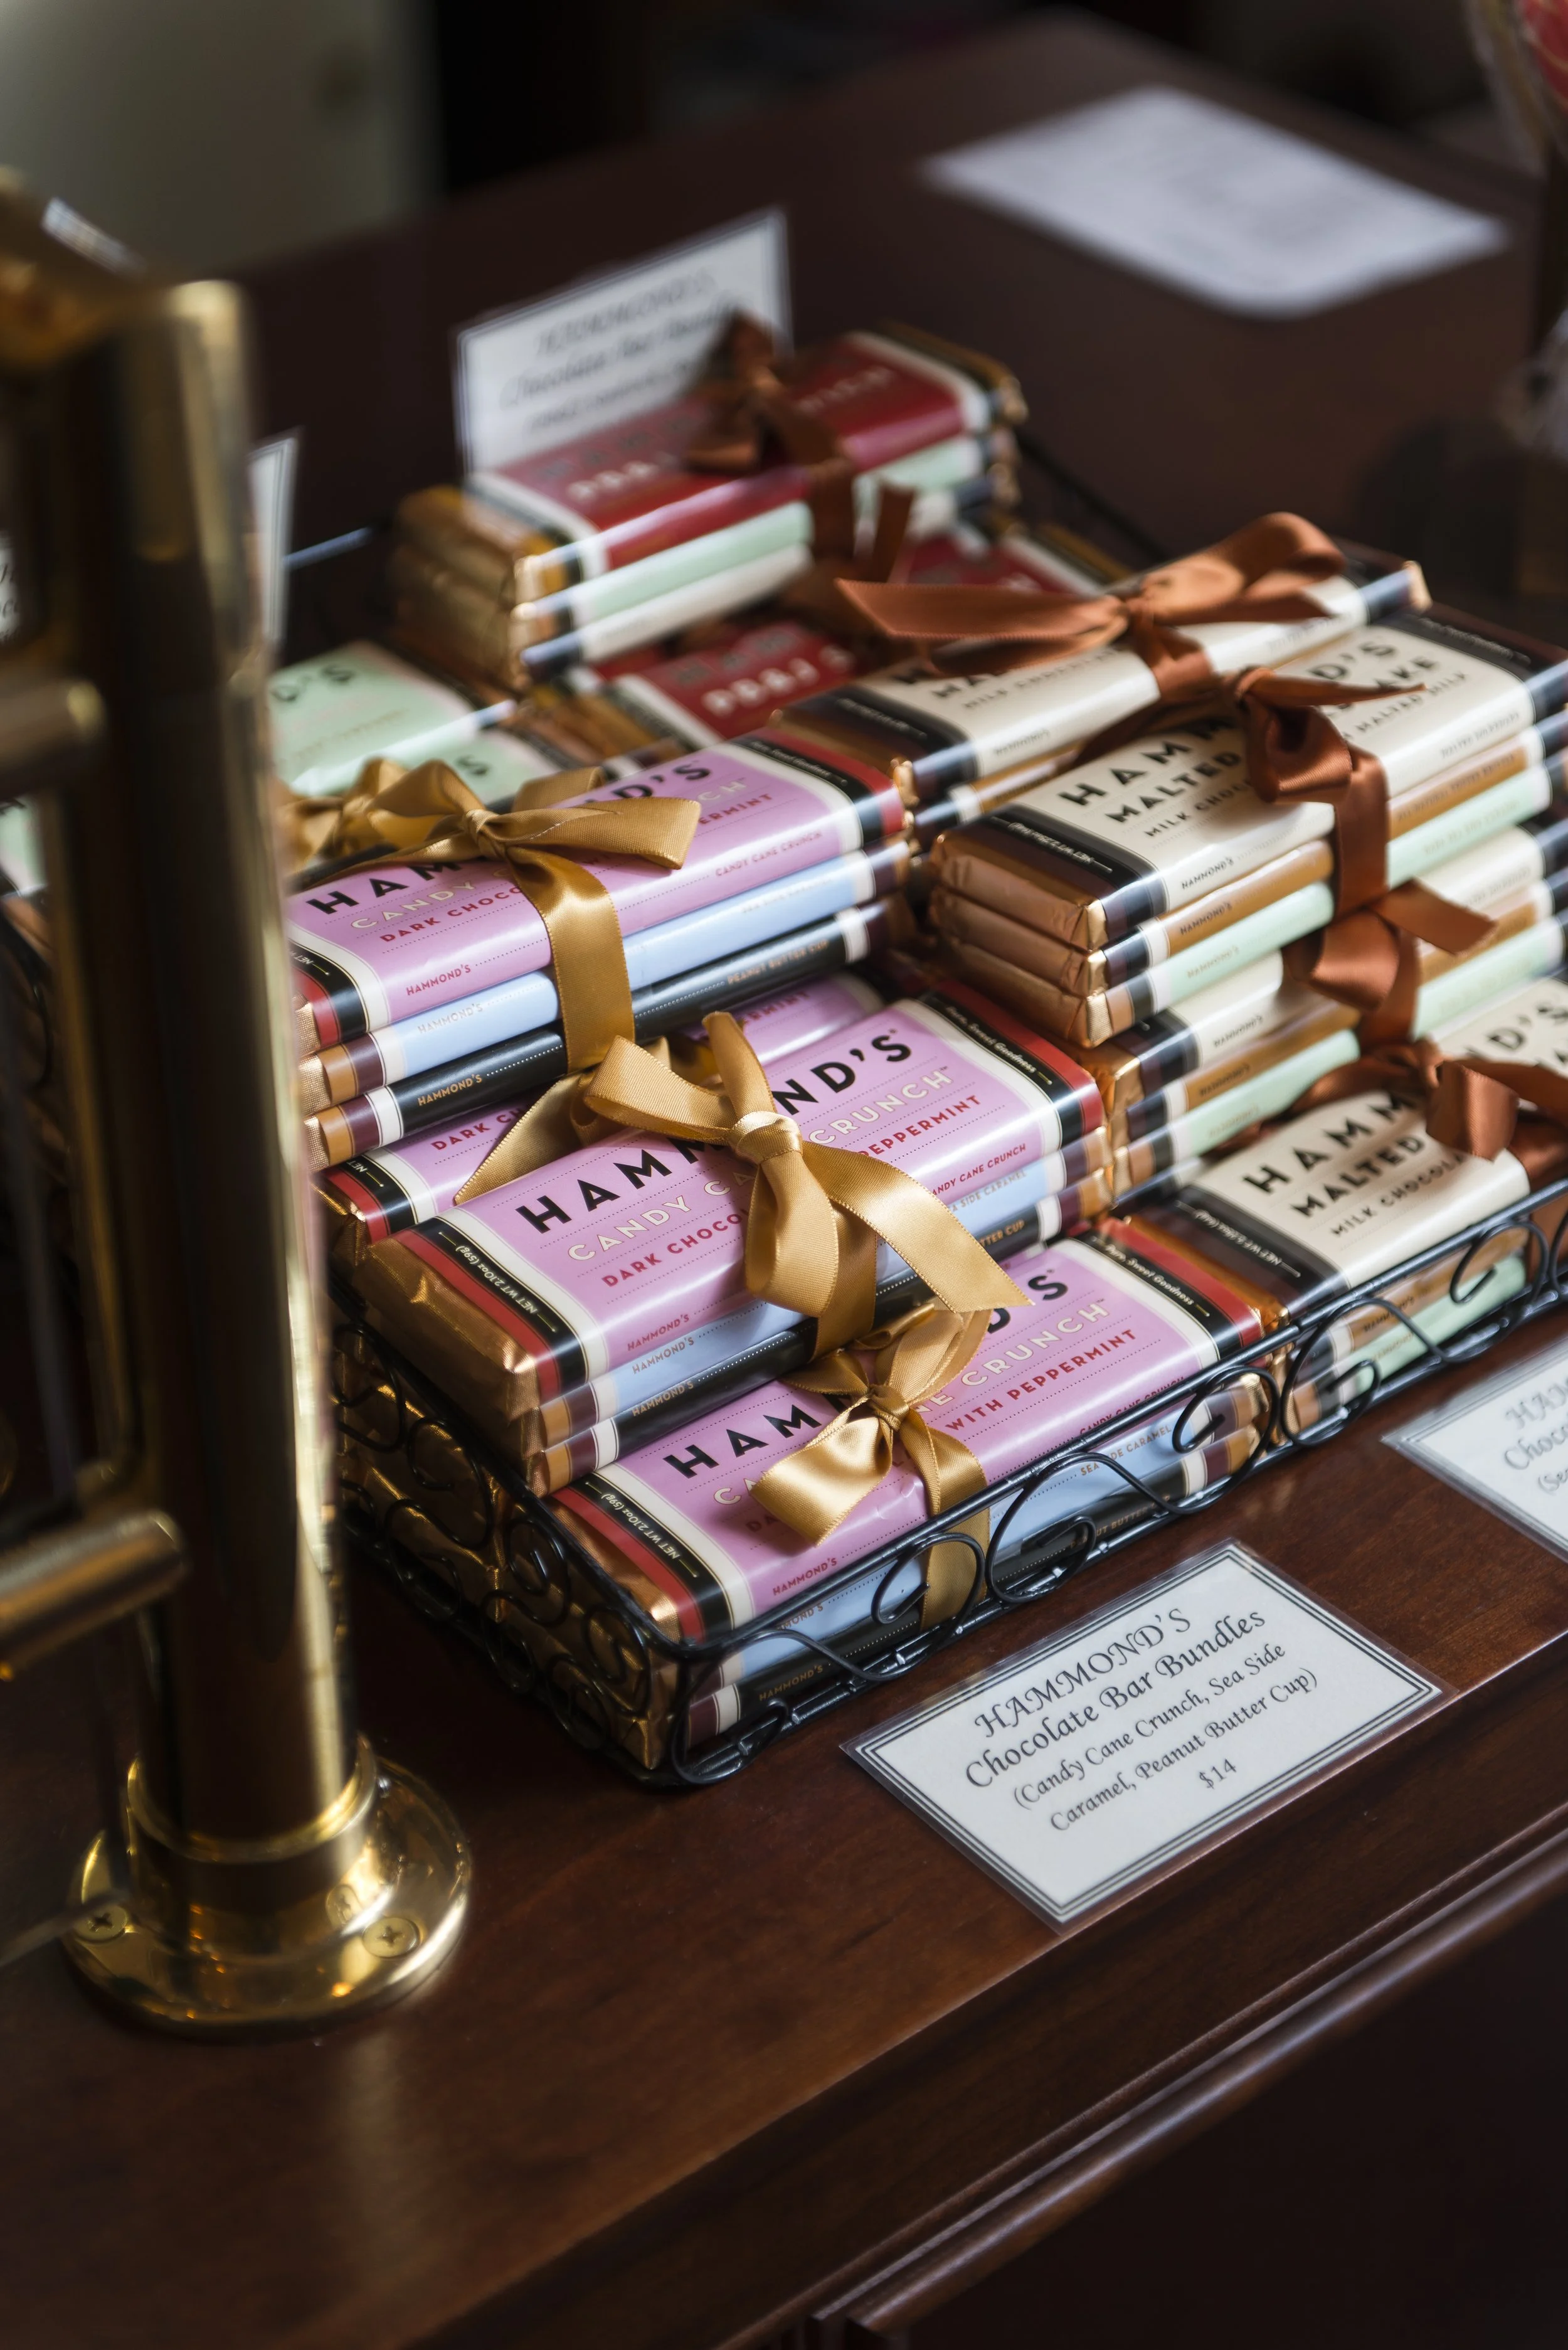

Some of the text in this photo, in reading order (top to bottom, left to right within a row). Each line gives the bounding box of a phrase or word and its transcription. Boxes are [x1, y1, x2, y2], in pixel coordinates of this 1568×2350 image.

[1104, 751, 1241, 822] MALTED
[1143, 812, 1189, 837] MILK
[379, 917, 440, 942] DARK
[447, 886, 522, 917] CHOCO
[699, 794, 773, 826] ERMINT
[1181, 856, 1234, 890] HAMMOND'S
[351, 881, 475, 929] CANDY
[1180, 901, 1233, 935] HAMMOND'S
[406, 964, 472, 996] HAMMOND'S
[417, 1004, 484, 1034] HAMMOND'S
[994, 1042, 1037, 1073] Goodness
[417, 1073, 483, 1106] HAMMOND'S
[431, 1123, 490, 1151] DARK
[568, 1196, 692, 1261] CANDY
[808, 1070, 954, 1145] CRUNCH
[1291, 1134, 1425, 1218] MALTED
[627, 1143, 1027, 1351] HAMMOND'S ANDY CANE CRUNCH
[978, 1230, 1004, 1248] TTER
[1005, 1219, 1025, 1236] CUP
[1330, 1206, 1377, 1237] MILK
[601, 1253, 661, 1289] DARK
[667, 1212, 744, 1255] CHOCO
[632, 1337, 694, 1374] HAMMOND'S
[960, 1189, 983, 1208] SIDE
[985, 1169, 1028, 1196] CARAMEL
[455, 1245, 538, 1314] NET WT 2.10oz (59g)
[1152, 1274, 1194, 1305] Goodness
[961, 1304, 1110, 1387] CRUNCH
[945, 1400, 1004, 1431] WITH
[1007, 1329, 1136, 1400] PEPPERMINT
[1081, 1463, 1099, 1476] SEA
[1126, 1425, 1172, 1452] CARAMEL
[601, 1493, 681, 1560] NET WT 2.10oz (59g)
[772, 1558, 837, 1596] HAMMOND'S
[759, 1665, 824, 1701] HAMMOND'S
[974, 1607, 1192, 1738] HAMMOND'S
[966, 1610, 1266, 1788] Chocolate Bar Bundles
[1014, 1643, 1286, 1810] (Candy Cane Crunch, Sea Side
[1051, 1667, 1318, 1831] Caramel, Peanut Butter Cup)
[1198, 1758, 1237, 1790] $14
